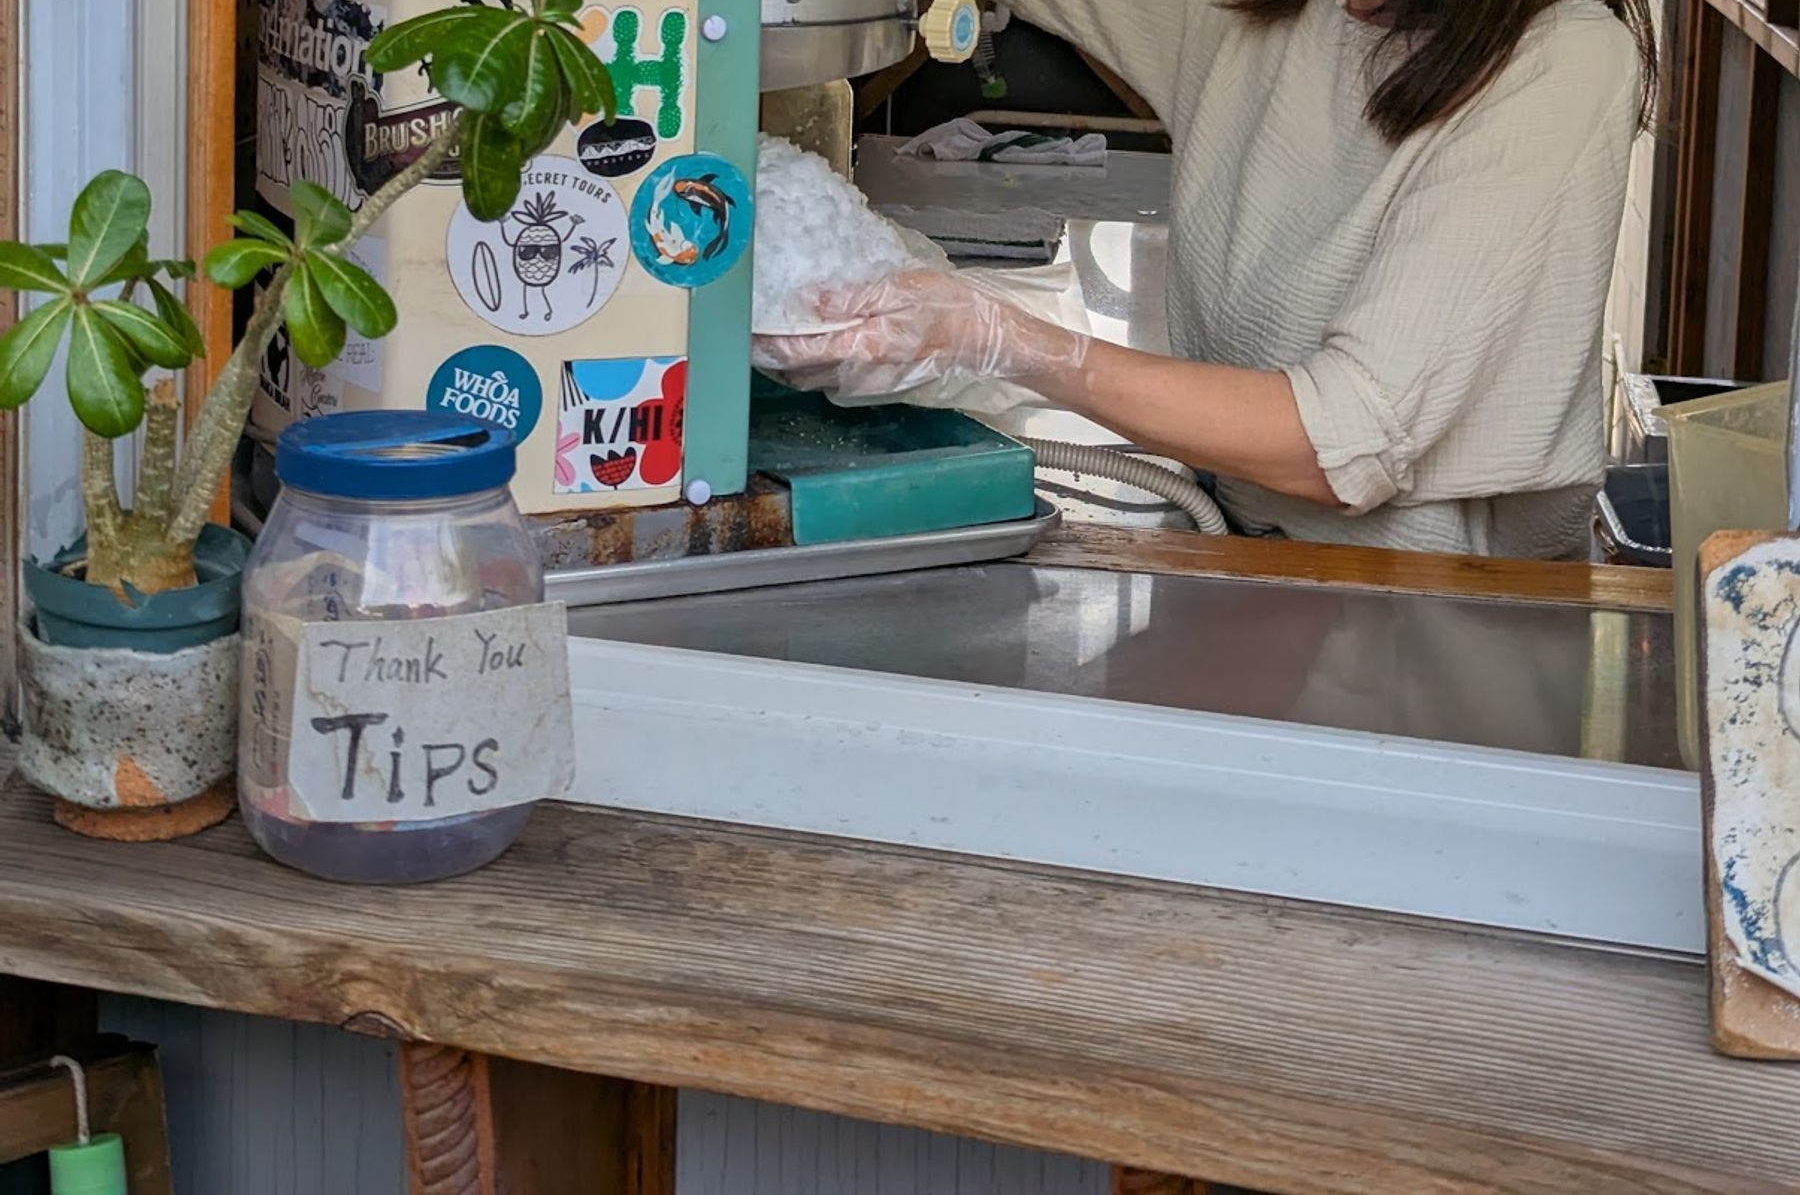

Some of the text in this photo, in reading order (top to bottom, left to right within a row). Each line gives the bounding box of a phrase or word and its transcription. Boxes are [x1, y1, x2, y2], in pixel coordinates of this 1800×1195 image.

[523, 171, 612, 203] ECRET TOURS
[440, 387, 521, 429] FOODS
[582, 406, 662, 445] K/HI
[319, 628, 527, 685] Thank You
